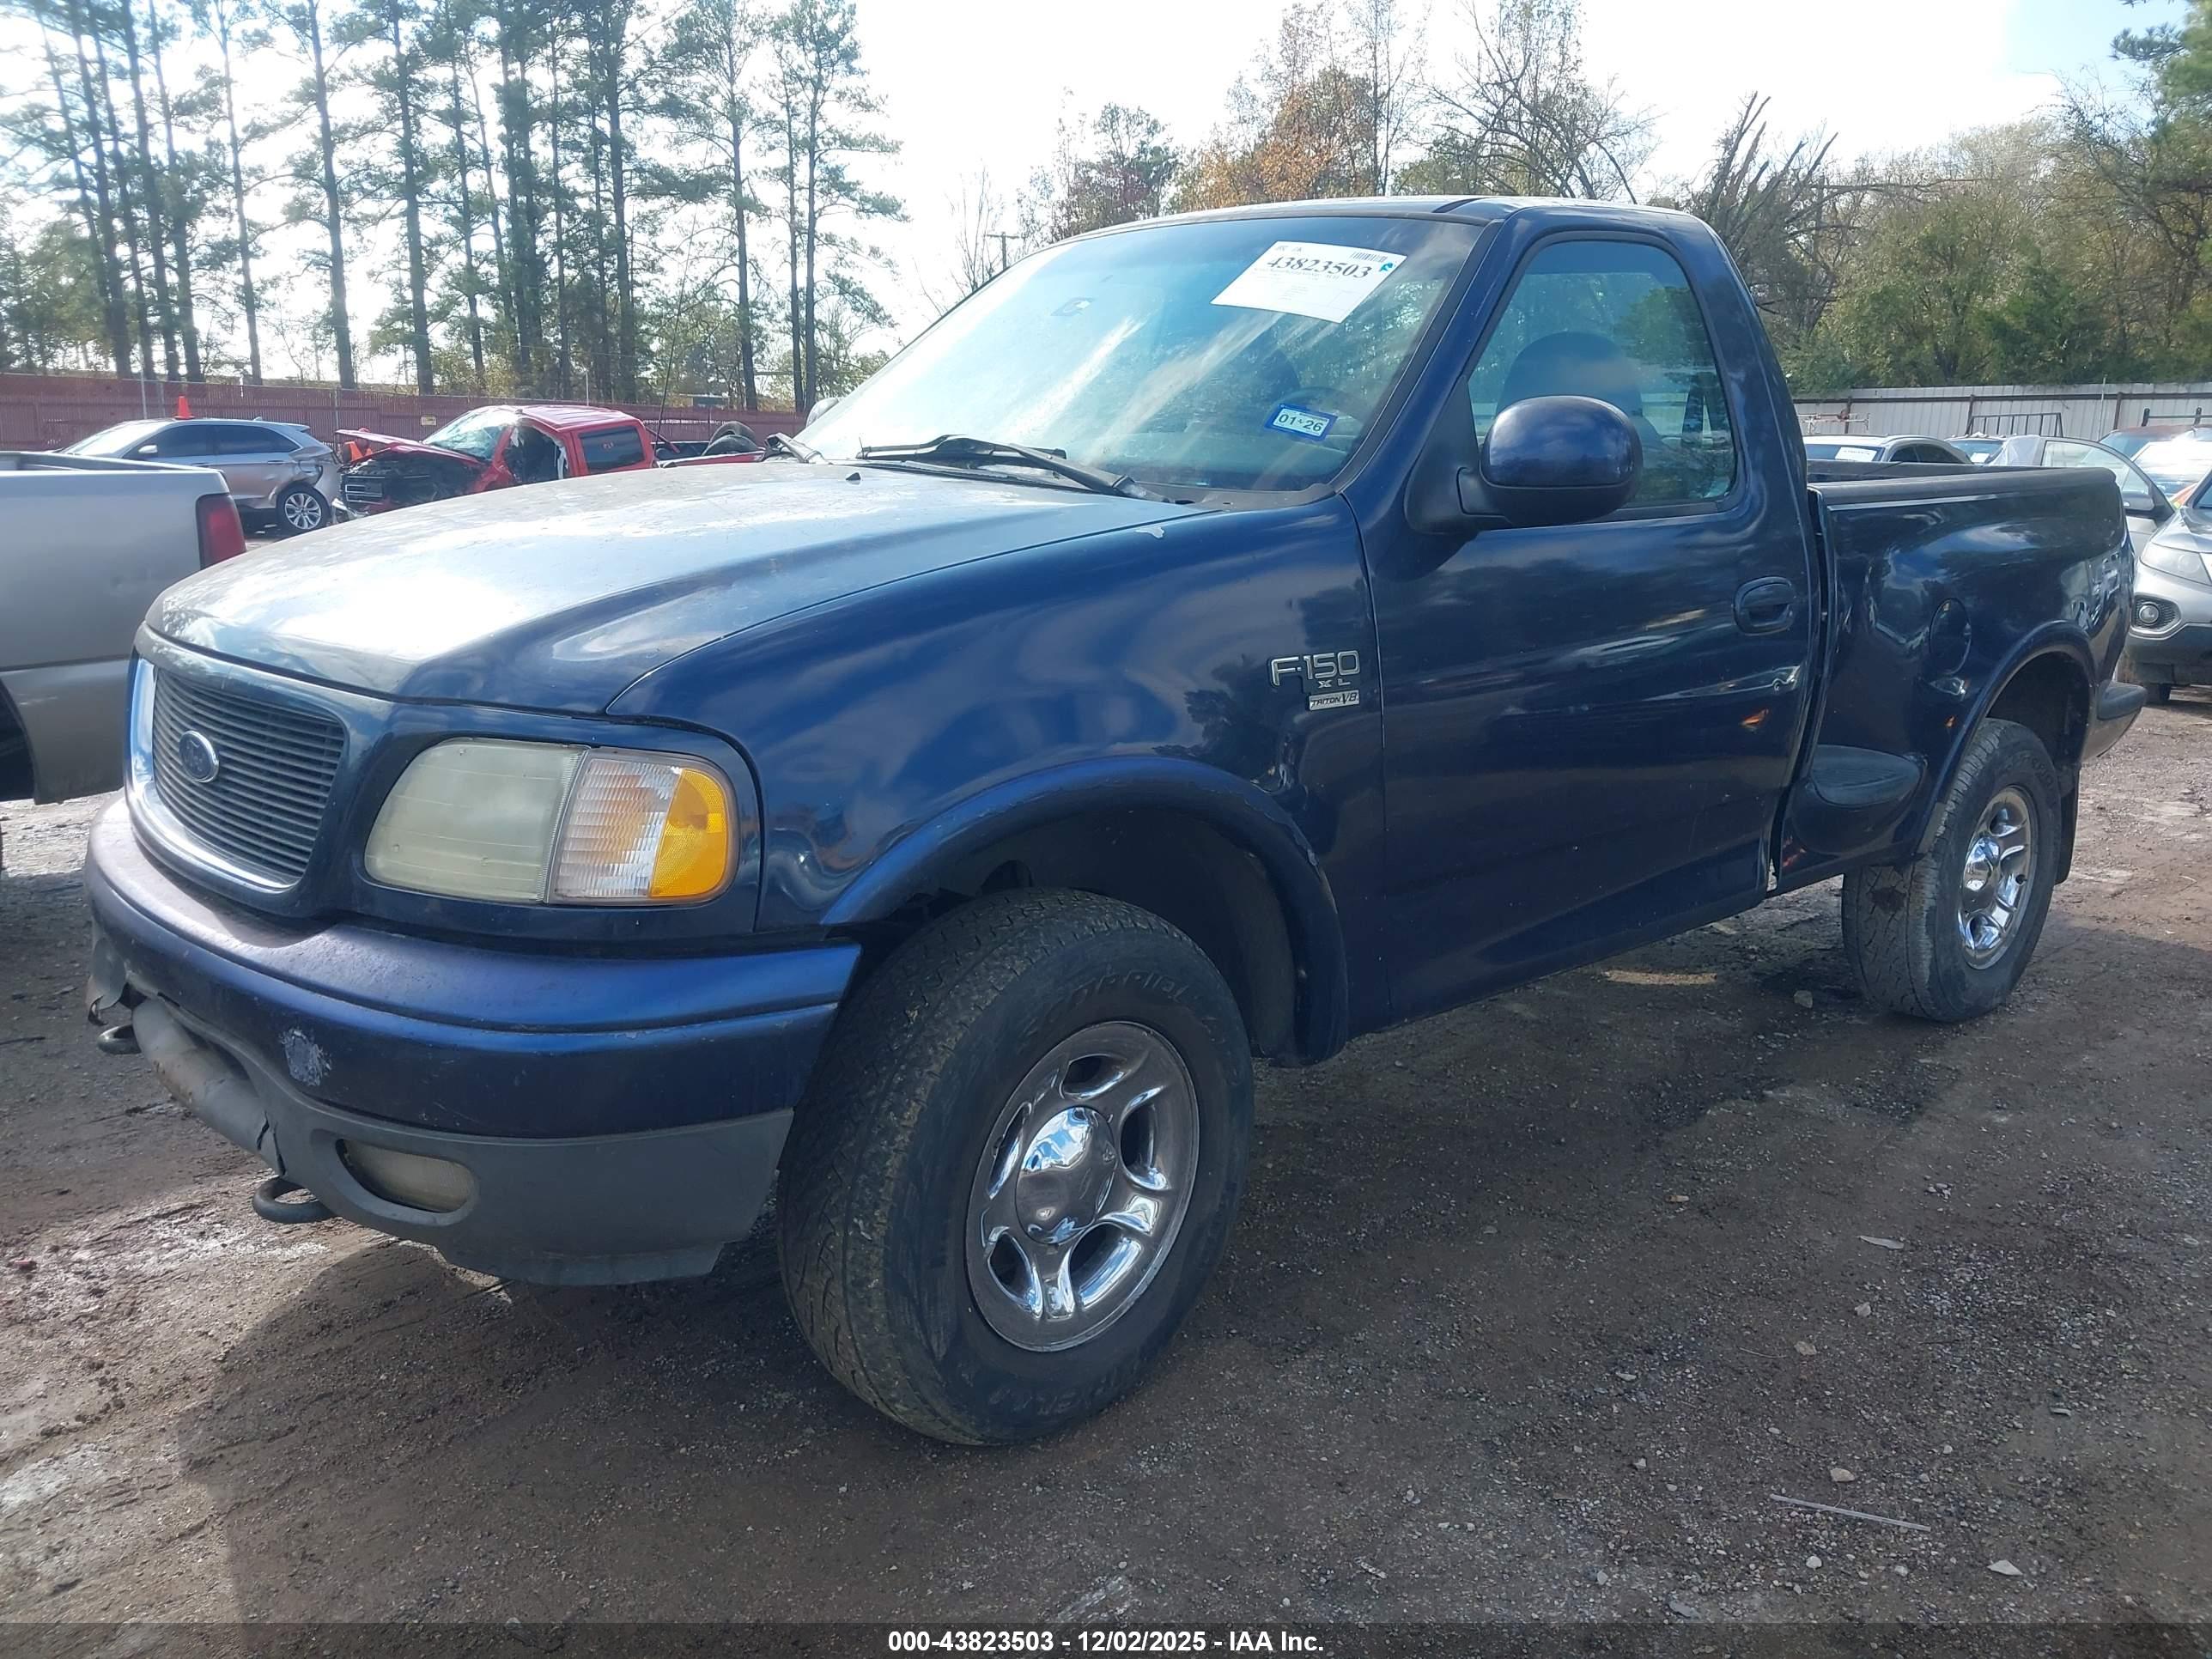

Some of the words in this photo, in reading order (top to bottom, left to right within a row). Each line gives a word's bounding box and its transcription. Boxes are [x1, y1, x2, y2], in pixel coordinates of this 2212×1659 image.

[1267, 257, 1372, 278] 43823503
[1279, 414, 1297, 425] 01
[1303, 420, 1324, 432] 26
[1310, 696, 1341, 708] TRITON
[1340, 692, 1357, 705] V8
